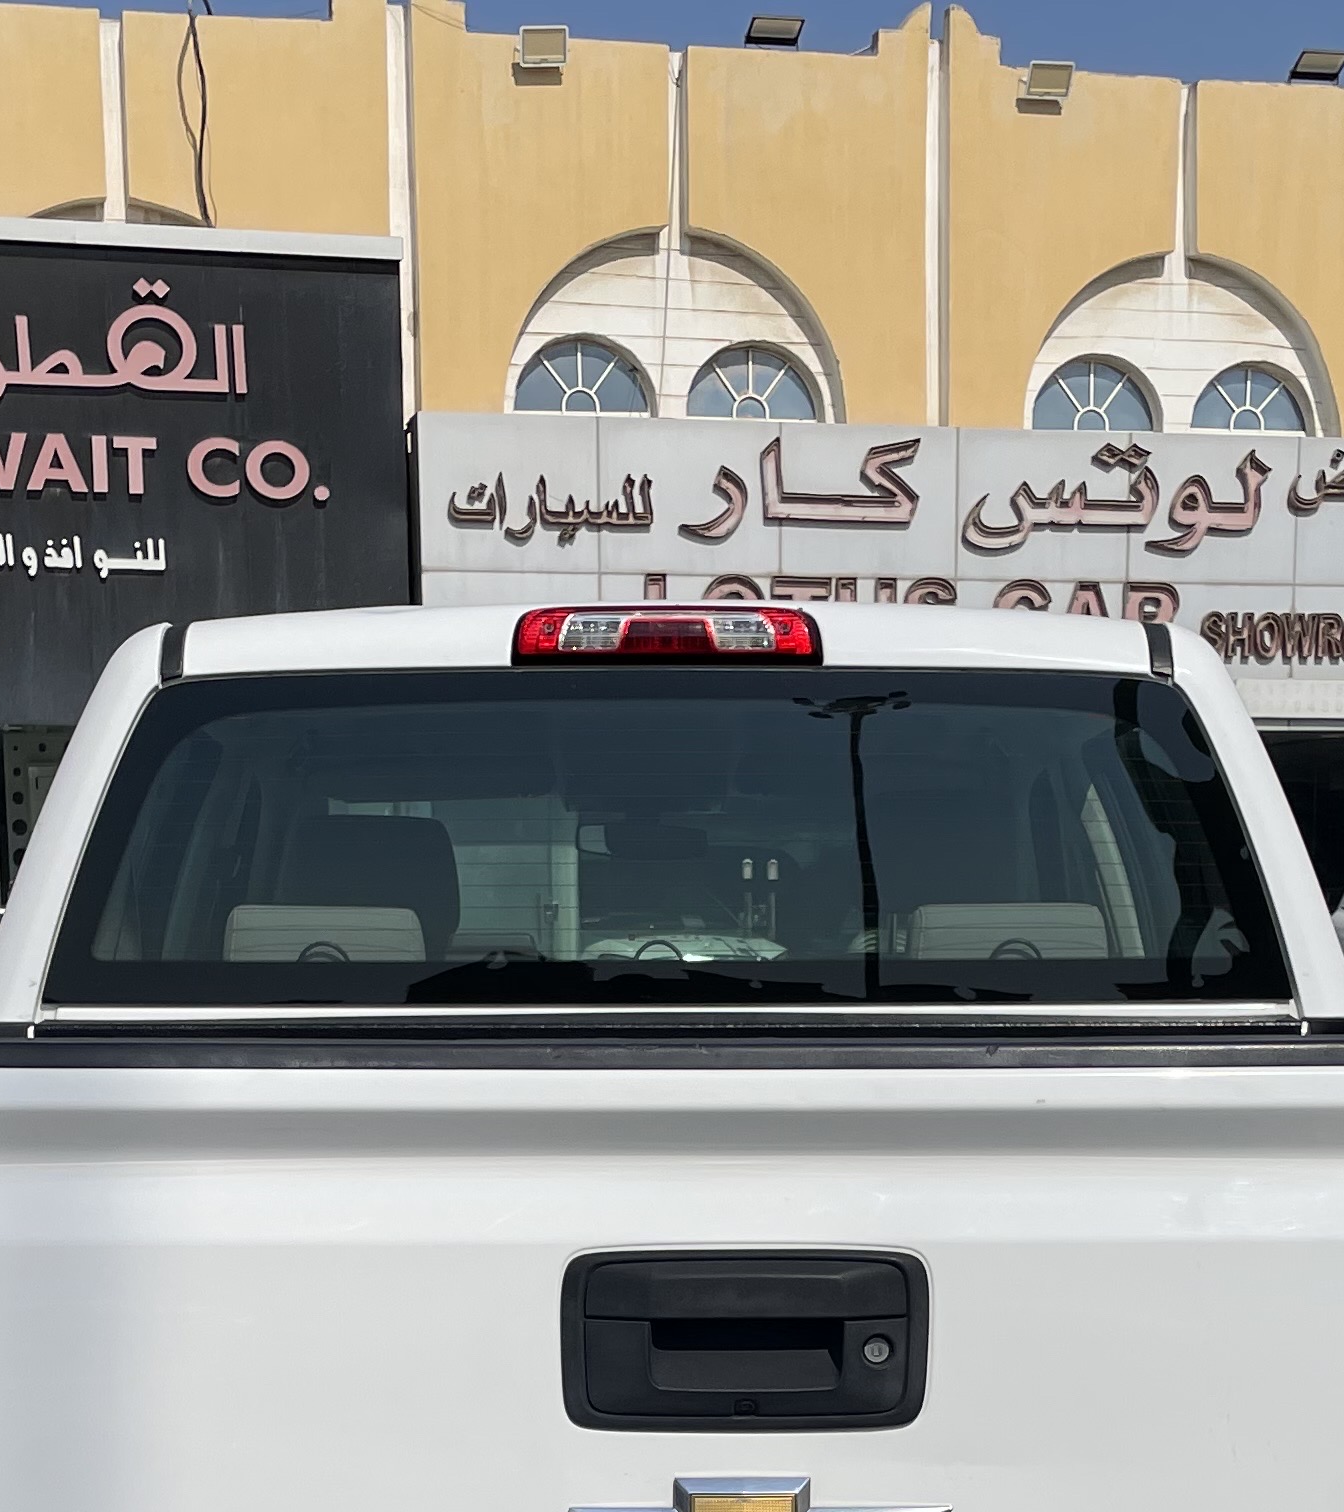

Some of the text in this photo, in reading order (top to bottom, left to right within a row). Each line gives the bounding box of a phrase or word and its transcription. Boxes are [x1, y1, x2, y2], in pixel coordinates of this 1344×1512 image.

[187, 437, 329, 501] CO.
[447, 472, 654, 543] للسيارات
[678, 437, 922, 540] كار
[961, 442, 1272, 553] لوتس
